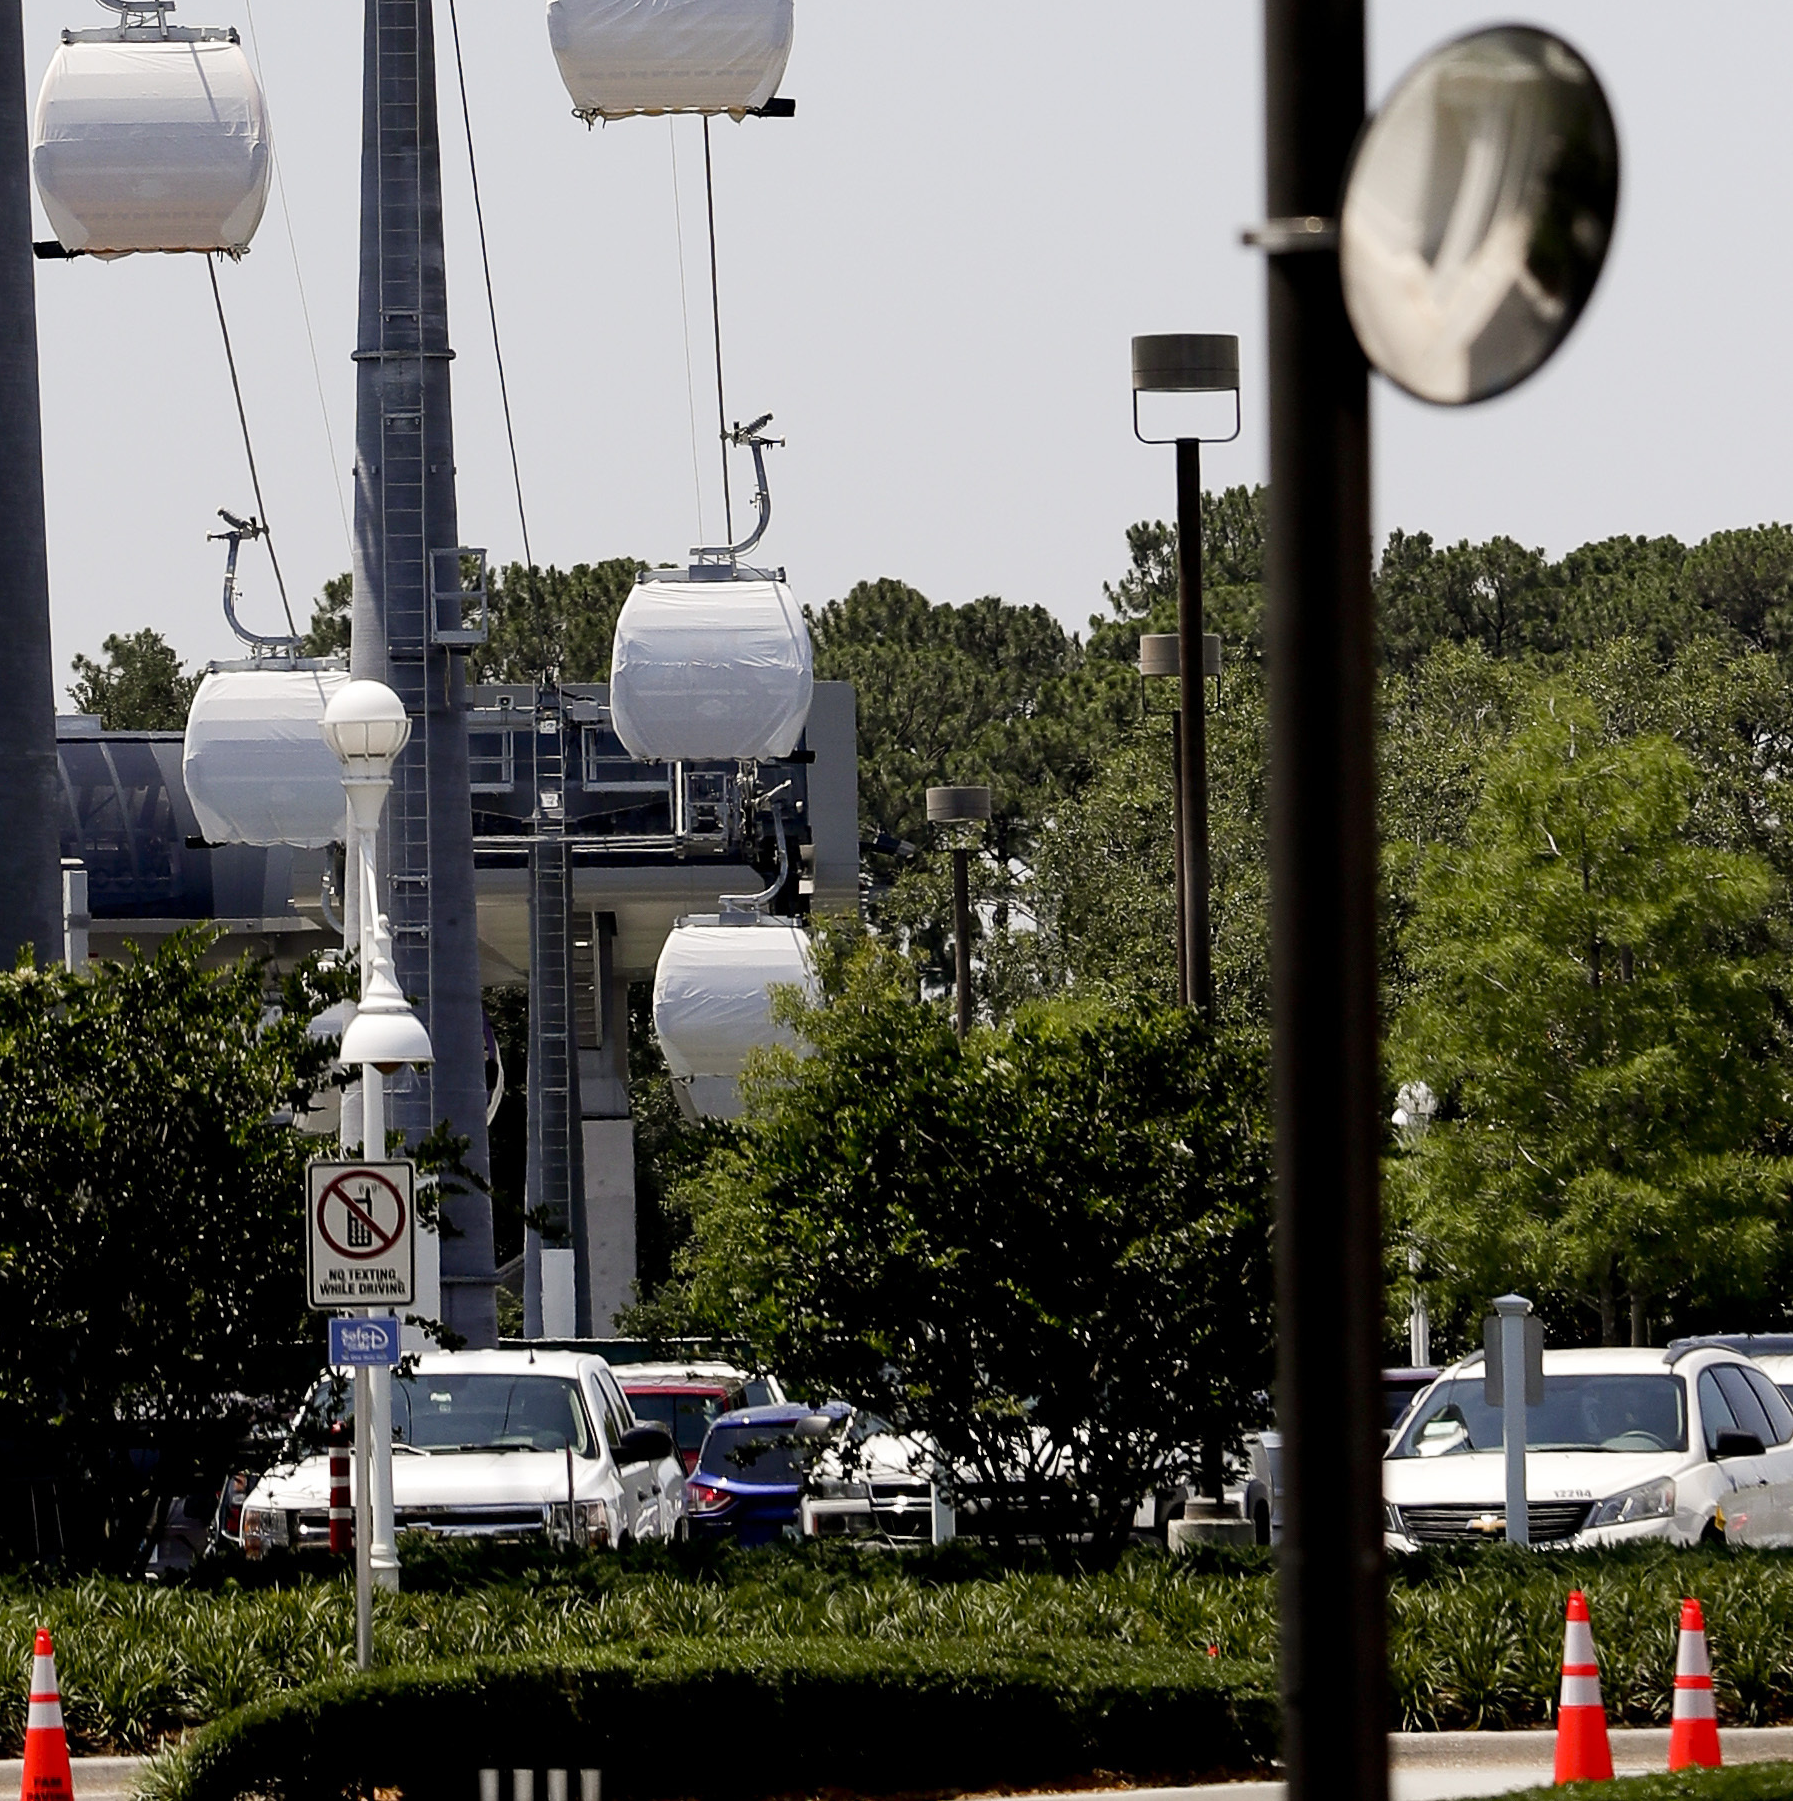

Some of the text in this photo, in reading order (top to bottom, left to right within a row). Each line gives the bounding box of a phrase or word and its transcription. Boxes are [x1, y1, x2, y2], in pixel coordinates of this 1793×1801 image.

[328, 1268, 396, 1280] NO TEXTING
[319, 1282, 405, 1295] WHILE DRIVING
